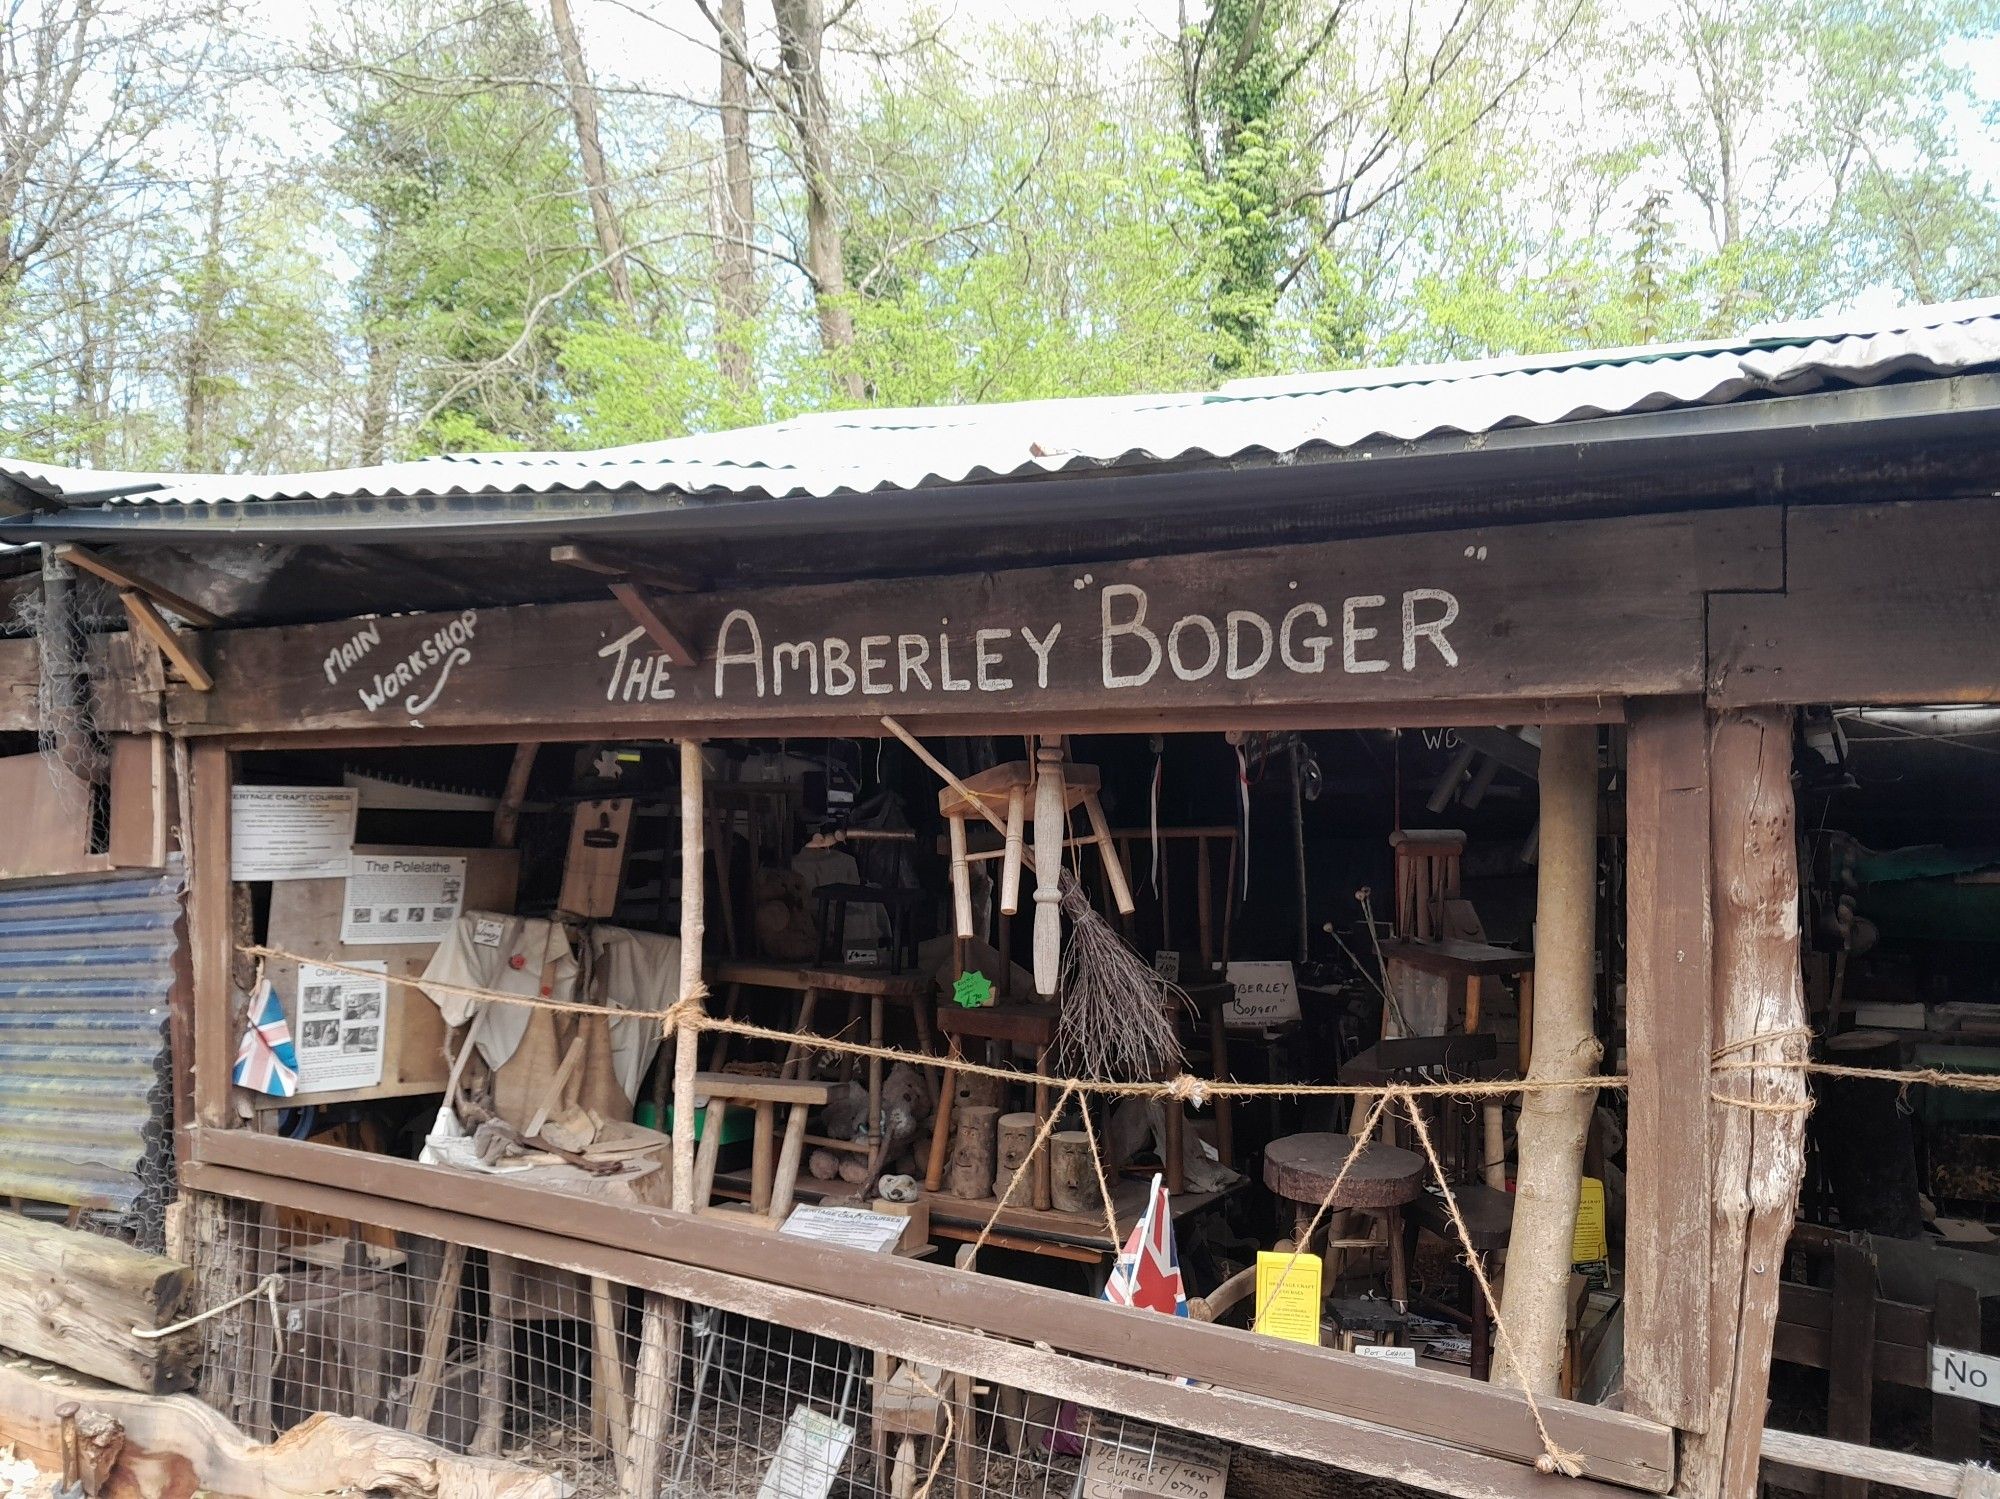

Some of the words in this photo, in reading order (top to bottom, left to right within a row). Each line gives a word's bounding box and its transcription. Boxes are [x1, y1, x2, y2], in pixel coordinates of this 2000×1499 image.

[323, 621, 381, 685] MAIN
[358, 609, 478, 712] WORKSHOP
[598, 625, 676, 701] THE
[714, 608, 1063, 698] AMBERLEY
[365, 860, 390, 873] The
[392, 860, 451, 874] Polelathe
[1944, 1356, 1988, 1388] No
[1183, 1469, 1216, 1485] TEXT
